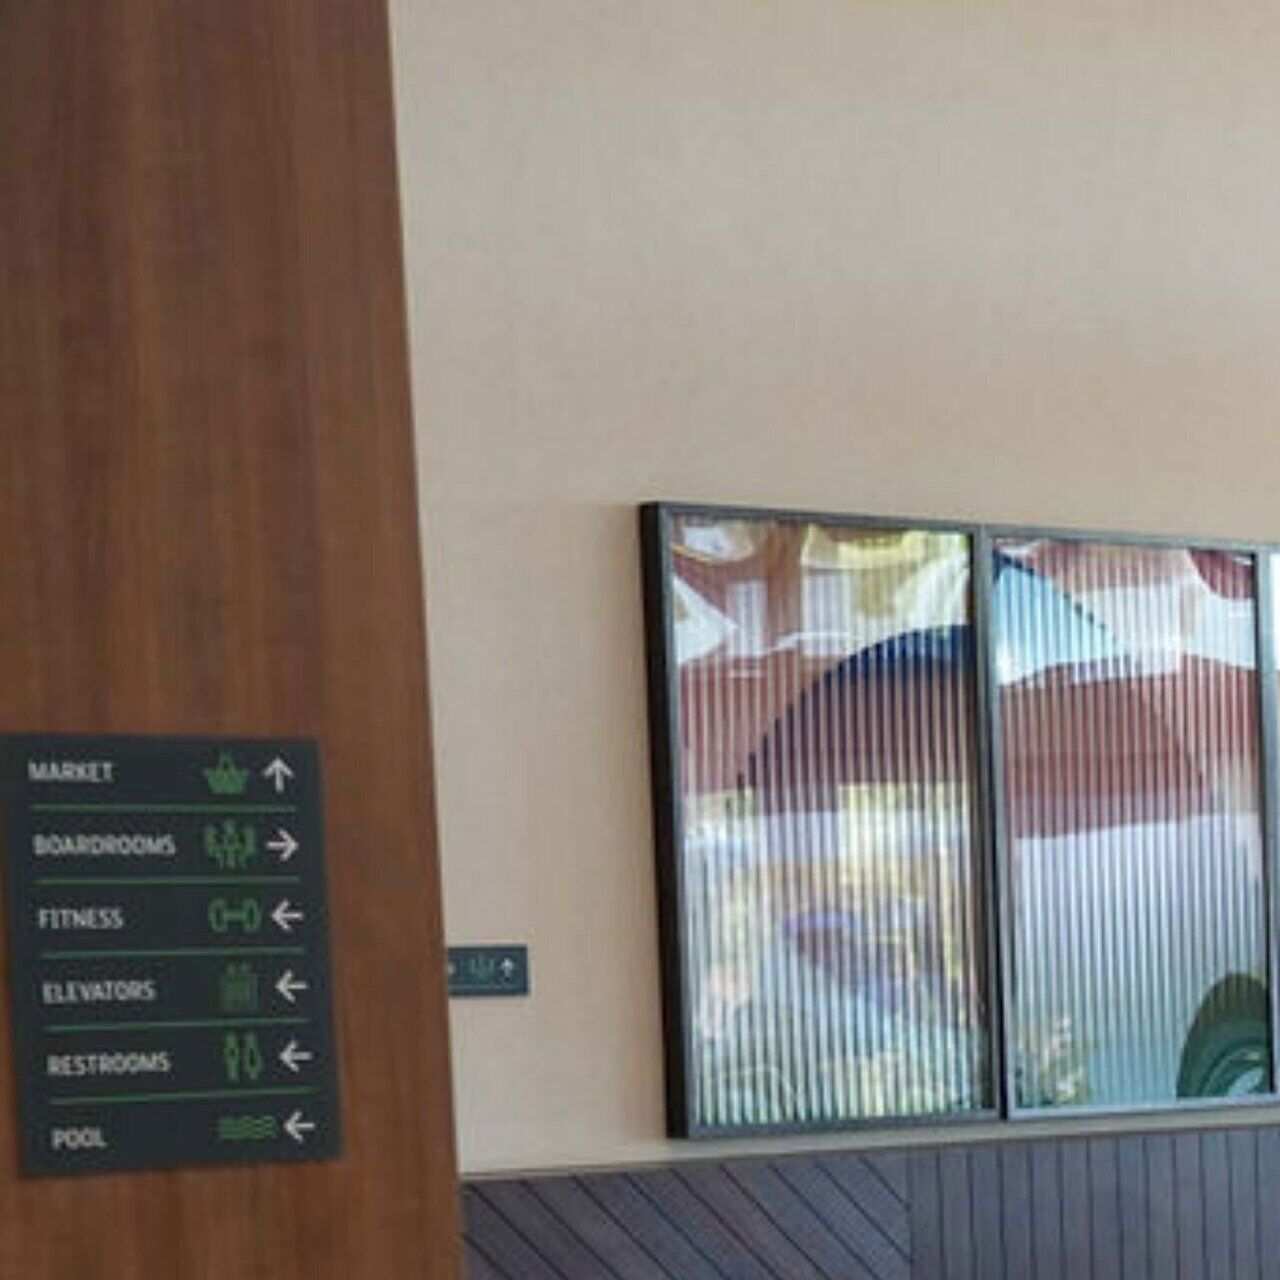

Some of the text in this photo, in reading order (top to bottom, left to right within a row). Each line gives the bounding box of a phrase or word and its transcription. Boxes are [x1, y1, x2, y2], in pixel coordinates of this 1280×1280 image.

[28, 761, 113, 784] MARKET
[33, 834, 176, 856] BOARDROOMS
[38, 908, 123, 930] FITNESS
[42, 980, 156, 1004] ELEVATORS
[47, 1052, 171, 1077] RESTROOMS
[52, 1127, 107, 1149] POOL
